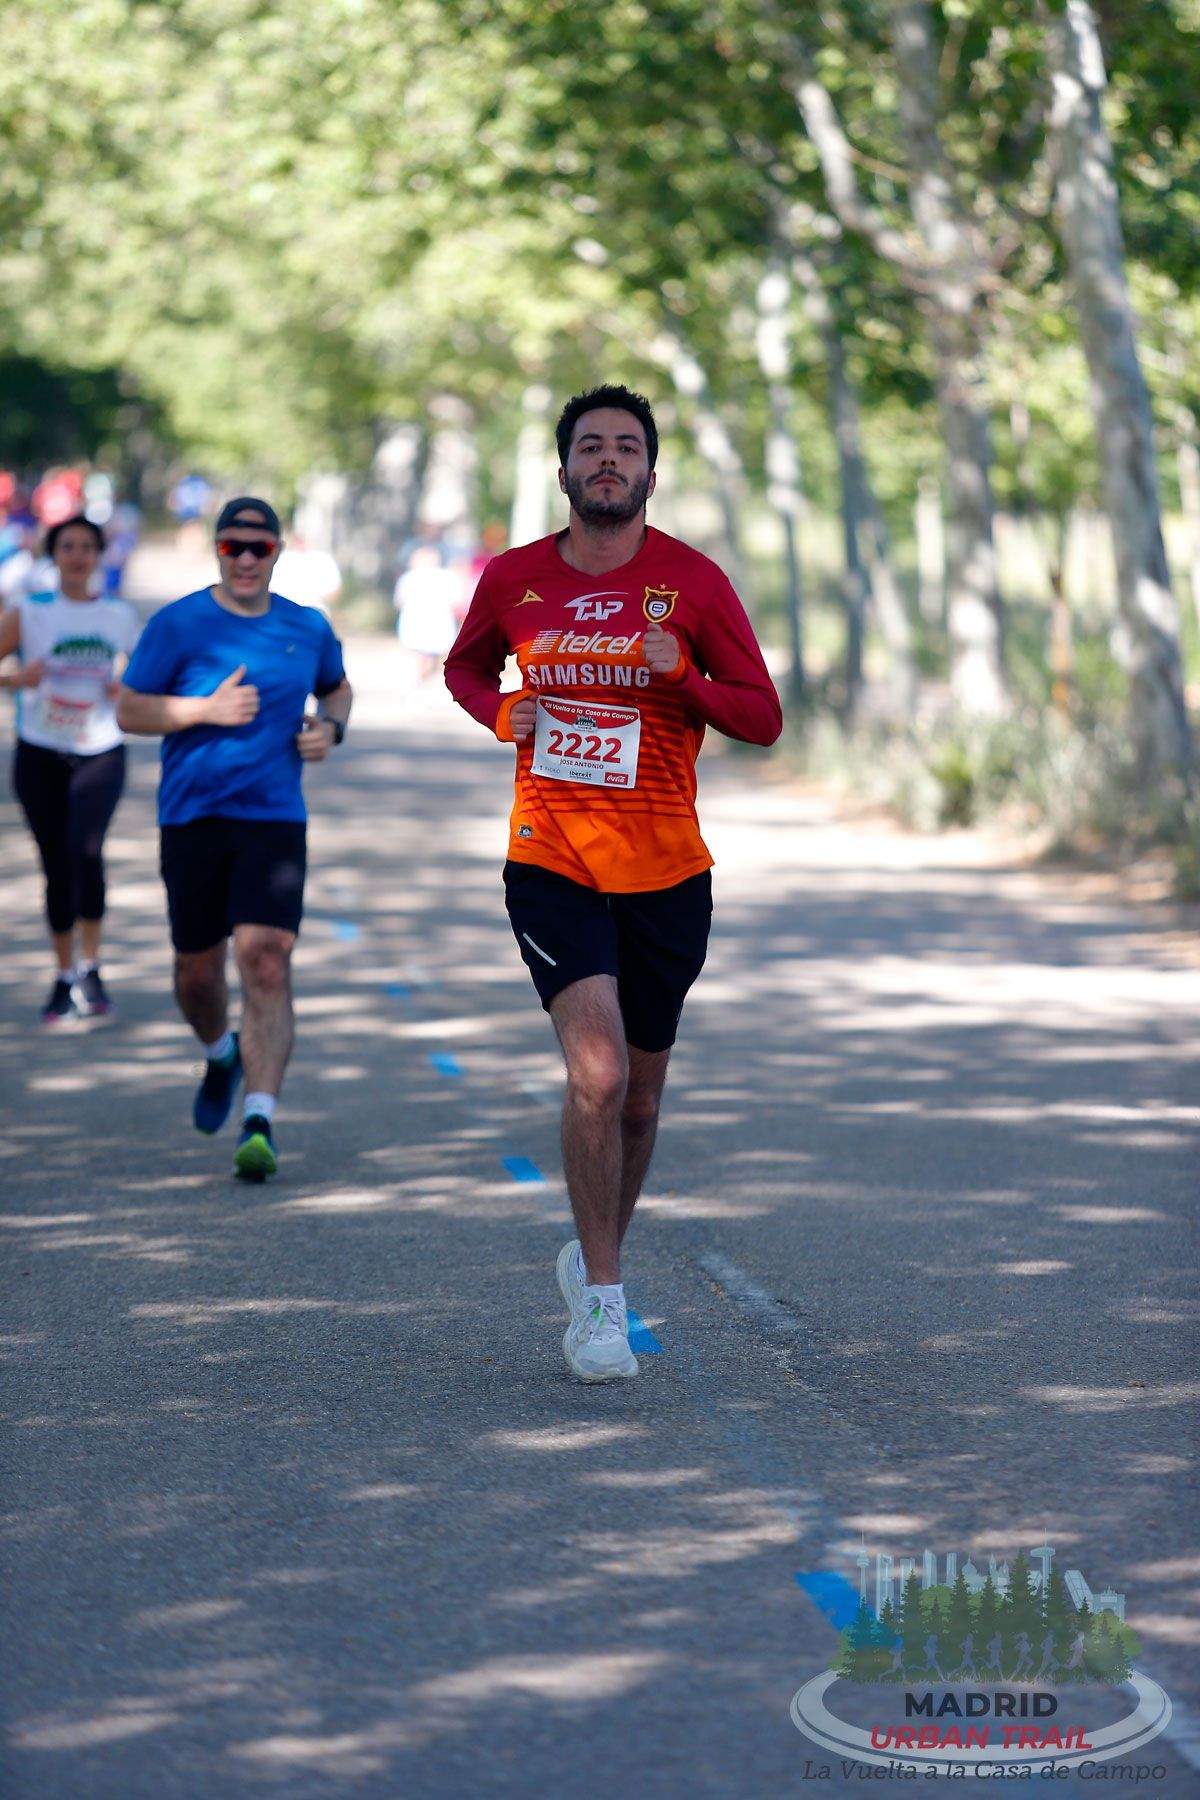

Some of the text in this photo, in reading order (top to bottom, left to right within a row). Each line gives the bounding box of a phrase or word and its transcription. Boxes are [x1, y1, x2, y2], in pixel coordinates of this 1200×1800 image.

[566, 597, 624, 621] TAP
[558, 629, 641, 655] telcel
[527, 663, 650, 688] SAMSUNG
[553, 703, 571, 713] Vuelta
[611, 712, 635, 720] Campo
[547, 729, 622, 763] 2222
[574, 760, 604, 769] ANTONIO
